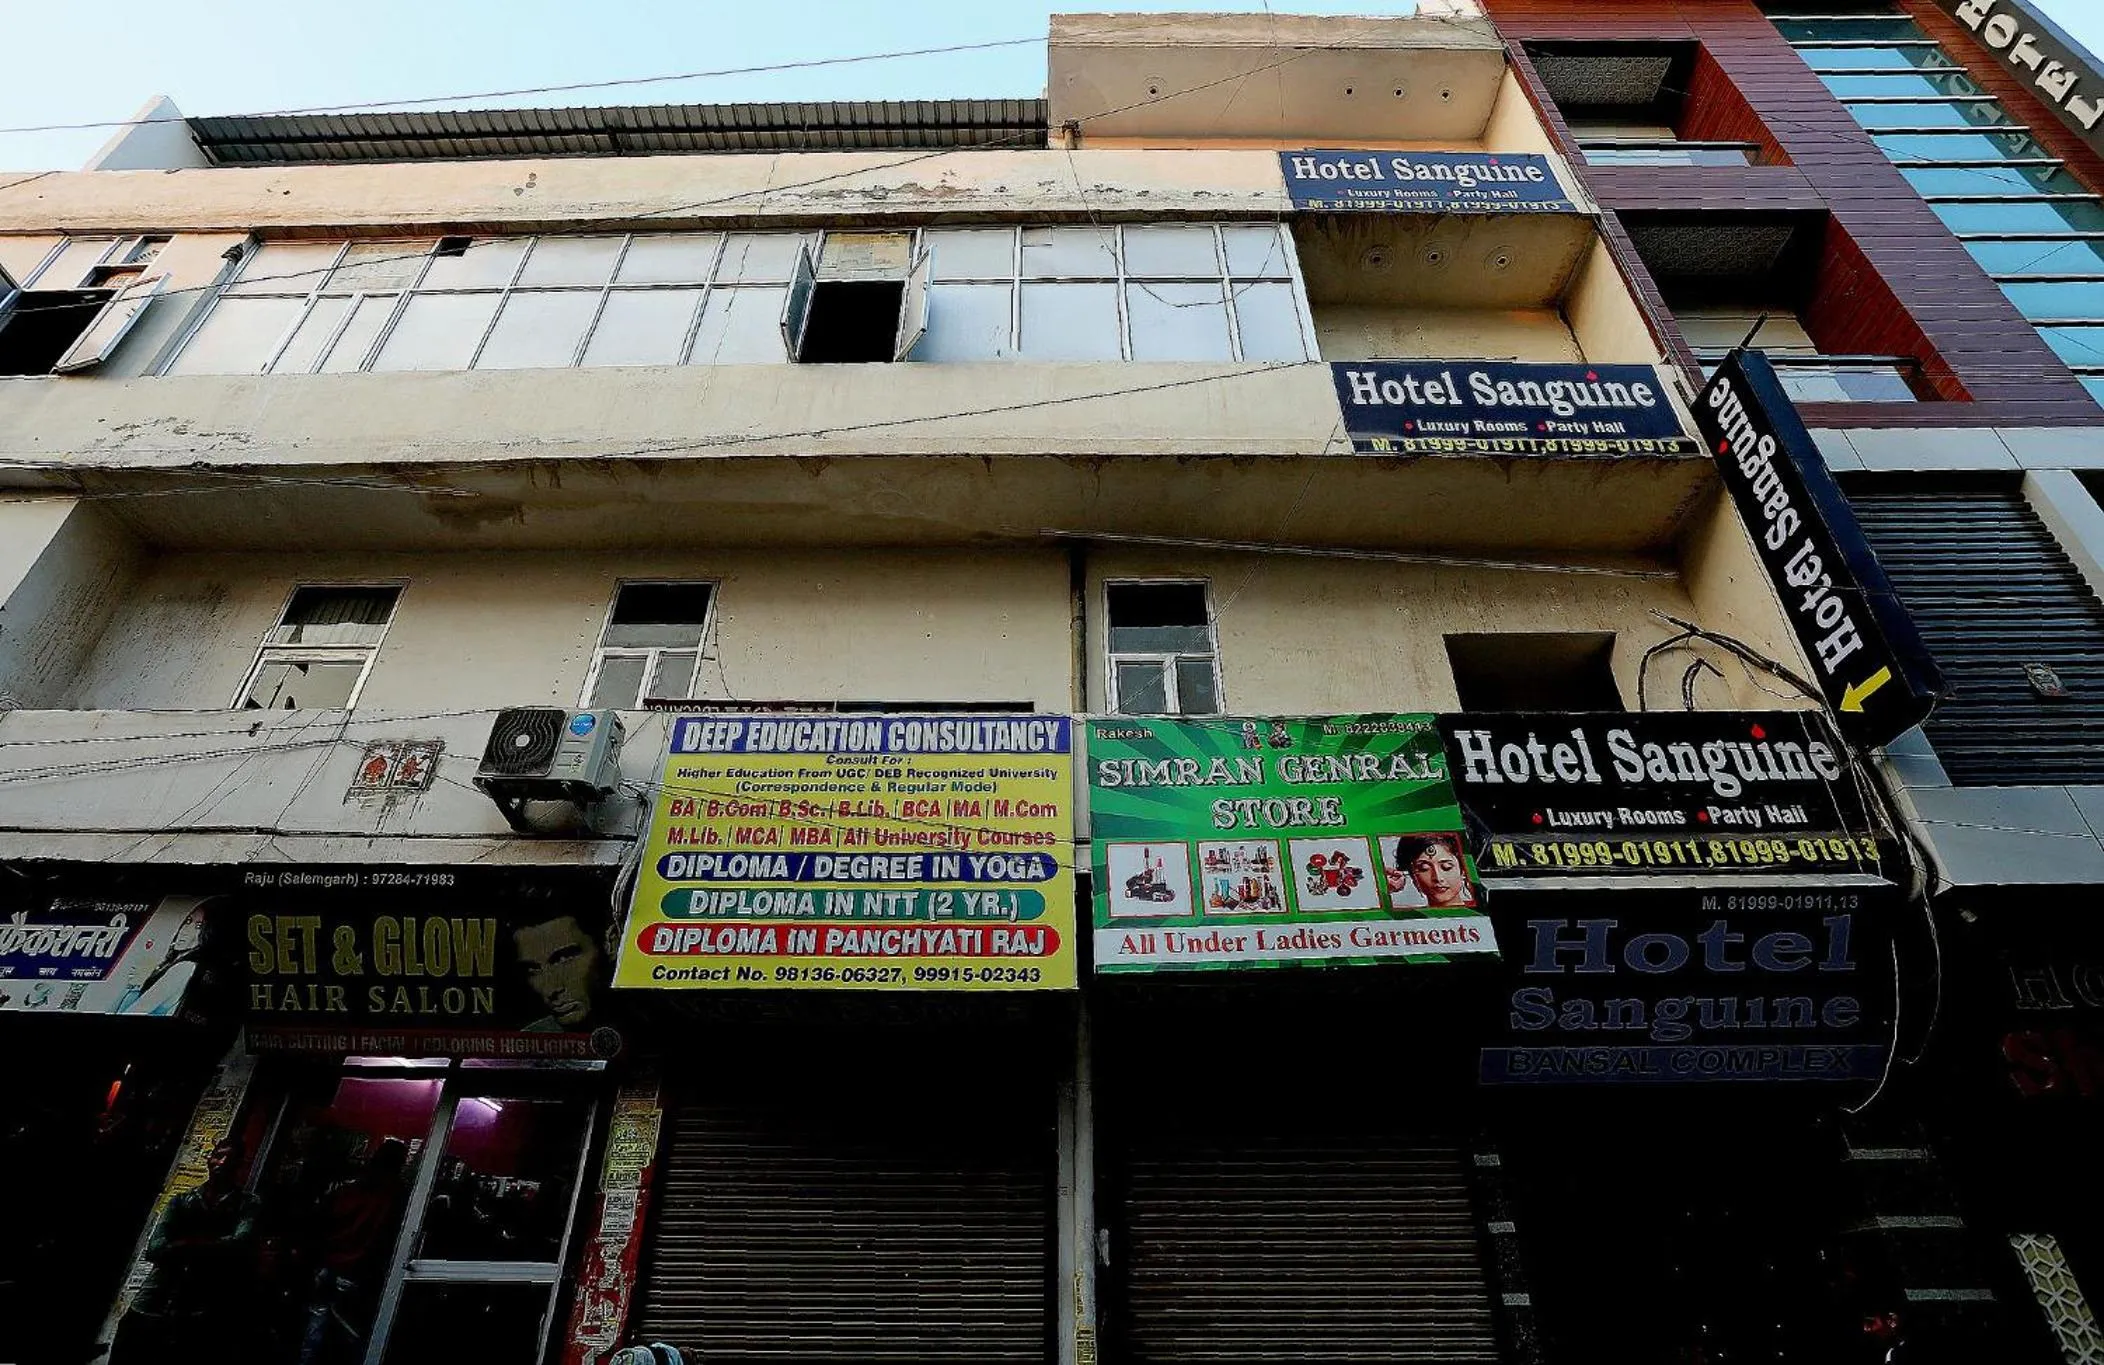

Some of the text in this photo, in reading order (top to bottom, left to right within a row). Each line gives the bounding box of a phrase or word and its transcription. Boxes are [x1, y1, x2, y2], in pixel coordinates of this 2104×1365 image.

[1955, 0, 2104, 130] HOTEL
[1292, 156, 1545, 187] Hotel Sanguine
[1347, 188, 1439, 199] Luxury Rooms
[1452, 190, 1518, 200] Party Hall
[1347, 371, 1657, 416] Hotel Sanguine
[1416, 420, 1528, 434] Luxury Rooms
[1545, 421, 1626, 435] Party Hall
[1709, 377, 1865, 676] Hotel Sanguine
[682, 720, 1060, 751] DEEP EDUCATION CONSULTANCY
[1095, 728, 1153, 740] Rakesh
[826, 755, 878, 765] Consult
[882, 755, 902, 765] For
[1099, 752, 1444, 787] SIMRAN GENRAL
[1454, 728, 1840, 797] Hotel Sanguine
[677, 768, 721, 780] Higher
[726, 768, 794, 779] Education
[798, 768, 832, 779] From
[875, 768, 902, 779] DEB
[907, 768, 984, 780] Recognized
[990, 768, 1057, 780] University
[735, 782, 997, 795] (Correspondence & Regular Mode)
[669, 801, 695, 817] BA
[902, 801, 942, 817] BCA
[953, 801, 982, 817] MA
[993, 801, 1058, 818] M.Com
[1211, 797, 1347, 829] STORE
[1546, 808, 1686, 829] Luxury Rooms
[1707, 805, 1808, 828] Party Hall
[667, 827, 723, 845] M.Lib.
[735, 827, 778, 845] MCA
[789, 828, 832, 845] MBA
[875, 828, 971, 850] University
[977, 830, 1056, 846] Courses
[1492, 842, 1527, 866] M.
[666, 855, 788, 878] DIPLOMA
[814, 856, 923, 879] DEGREE
[932, 856, 960, 879] IN
[969, 856, 1046, 879] YOGA
[245, 873, 274, 886] Raju
[279, 873, 358, 887] (Salemgarh)
[372, 873, 455, 886] 97284-71983
[688, 890, 1018, 921] DIPLOMA IN NTT (2 YR.)
[1702, 896, 1721, 910] M.
[248, 915, 497, 977] SET & GLOW
[653, 928, 1045, 955] DIPLOMA IN PANCHYATI RAJ
[1119, 924, 1481, 954] All Under Ladies Garments
[1524, 915, 1856, 974] Hotel
[651, 965, 1041, 984] Contact No. 98136-06327, 99915-02343
[250, 985, 495, 1014] HAIR SALON
[1510, 988, 1860, 1042] Sanguine
[1507, 1047, 1851, 1076] BANSAL COMPLEX
